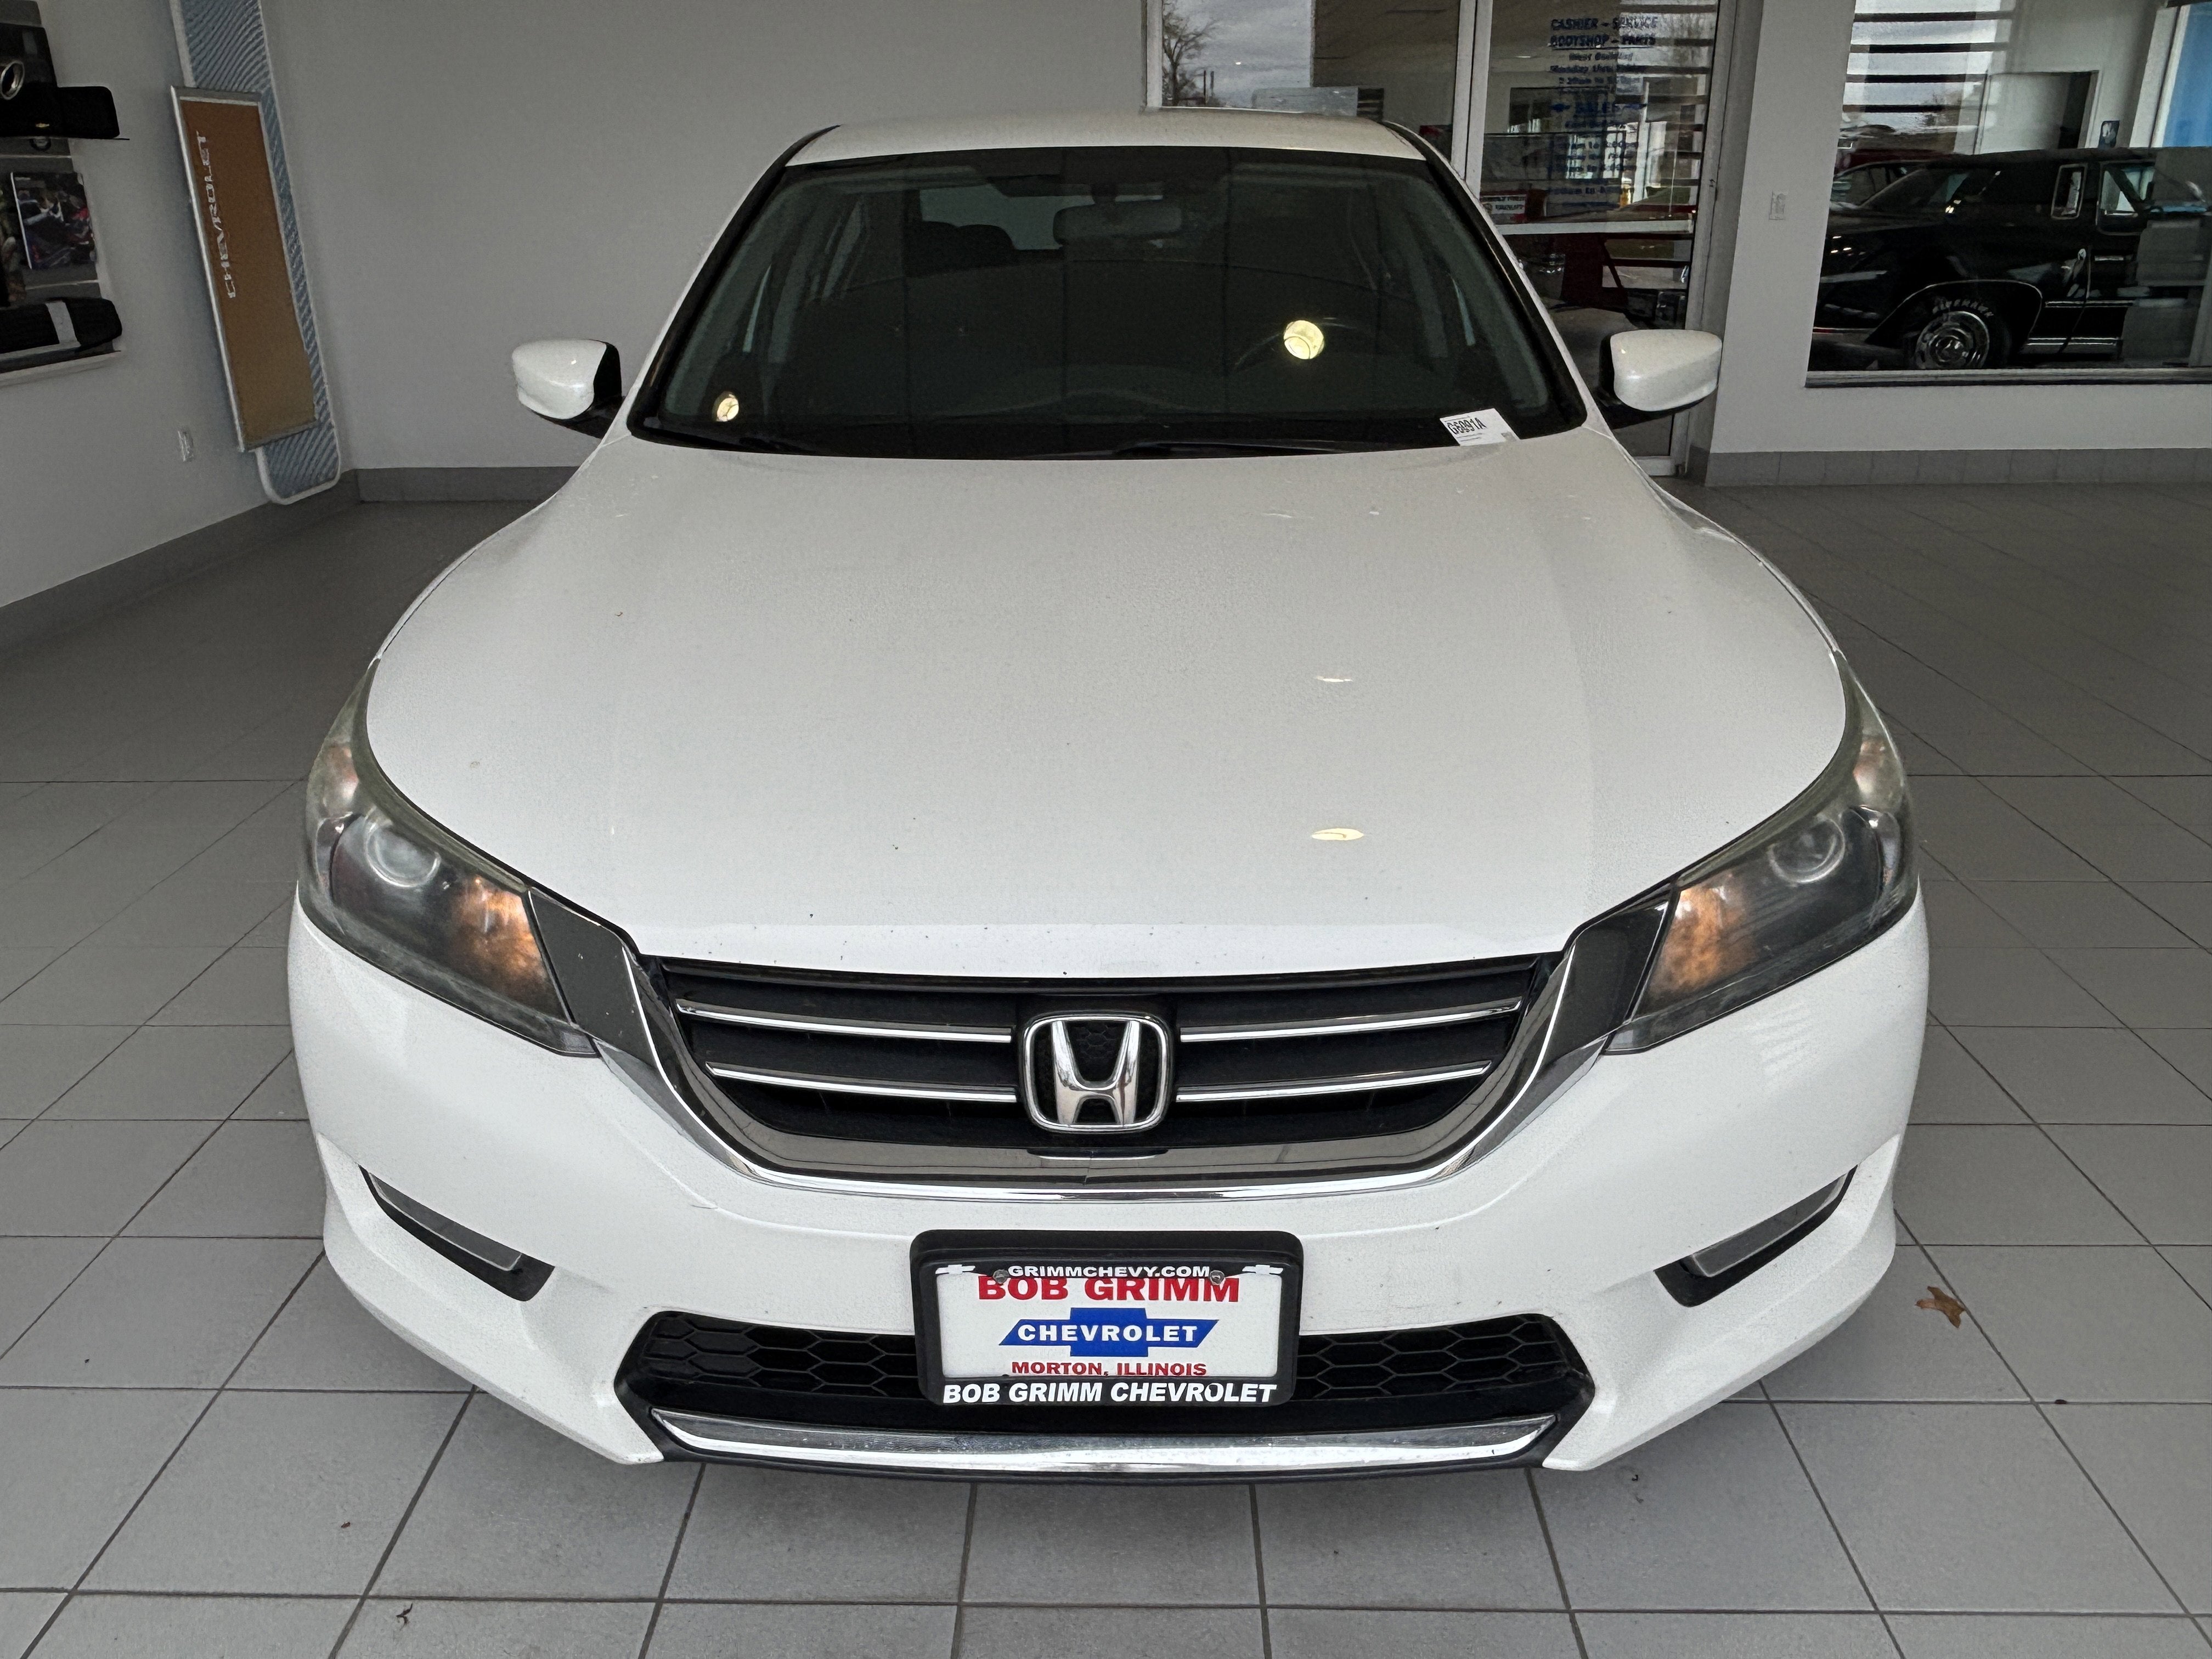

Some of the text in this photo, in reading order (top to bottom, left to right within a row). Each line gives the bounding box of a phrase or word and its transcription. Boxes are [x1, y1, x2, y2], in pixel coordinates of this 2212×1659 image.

[1551, 18, 1599, 30] CASHIER
[1550, 35, 1609, 47] BODYSHOP
[196, 130, 236, 298] CHEVROLET
[1008, 1265, 1210, 1277] GRIMMCHEVY.COM
[978, 1276, 1239, 1302] BOB GRIMM
[1018, 1324, 1197, 1341] CHEVROLET
[1012, 1362, 1207, 1376] MORTON, ILLINOIS
[943, 1382, 1277, 1403] BOB GRIMM CHEVROLET
